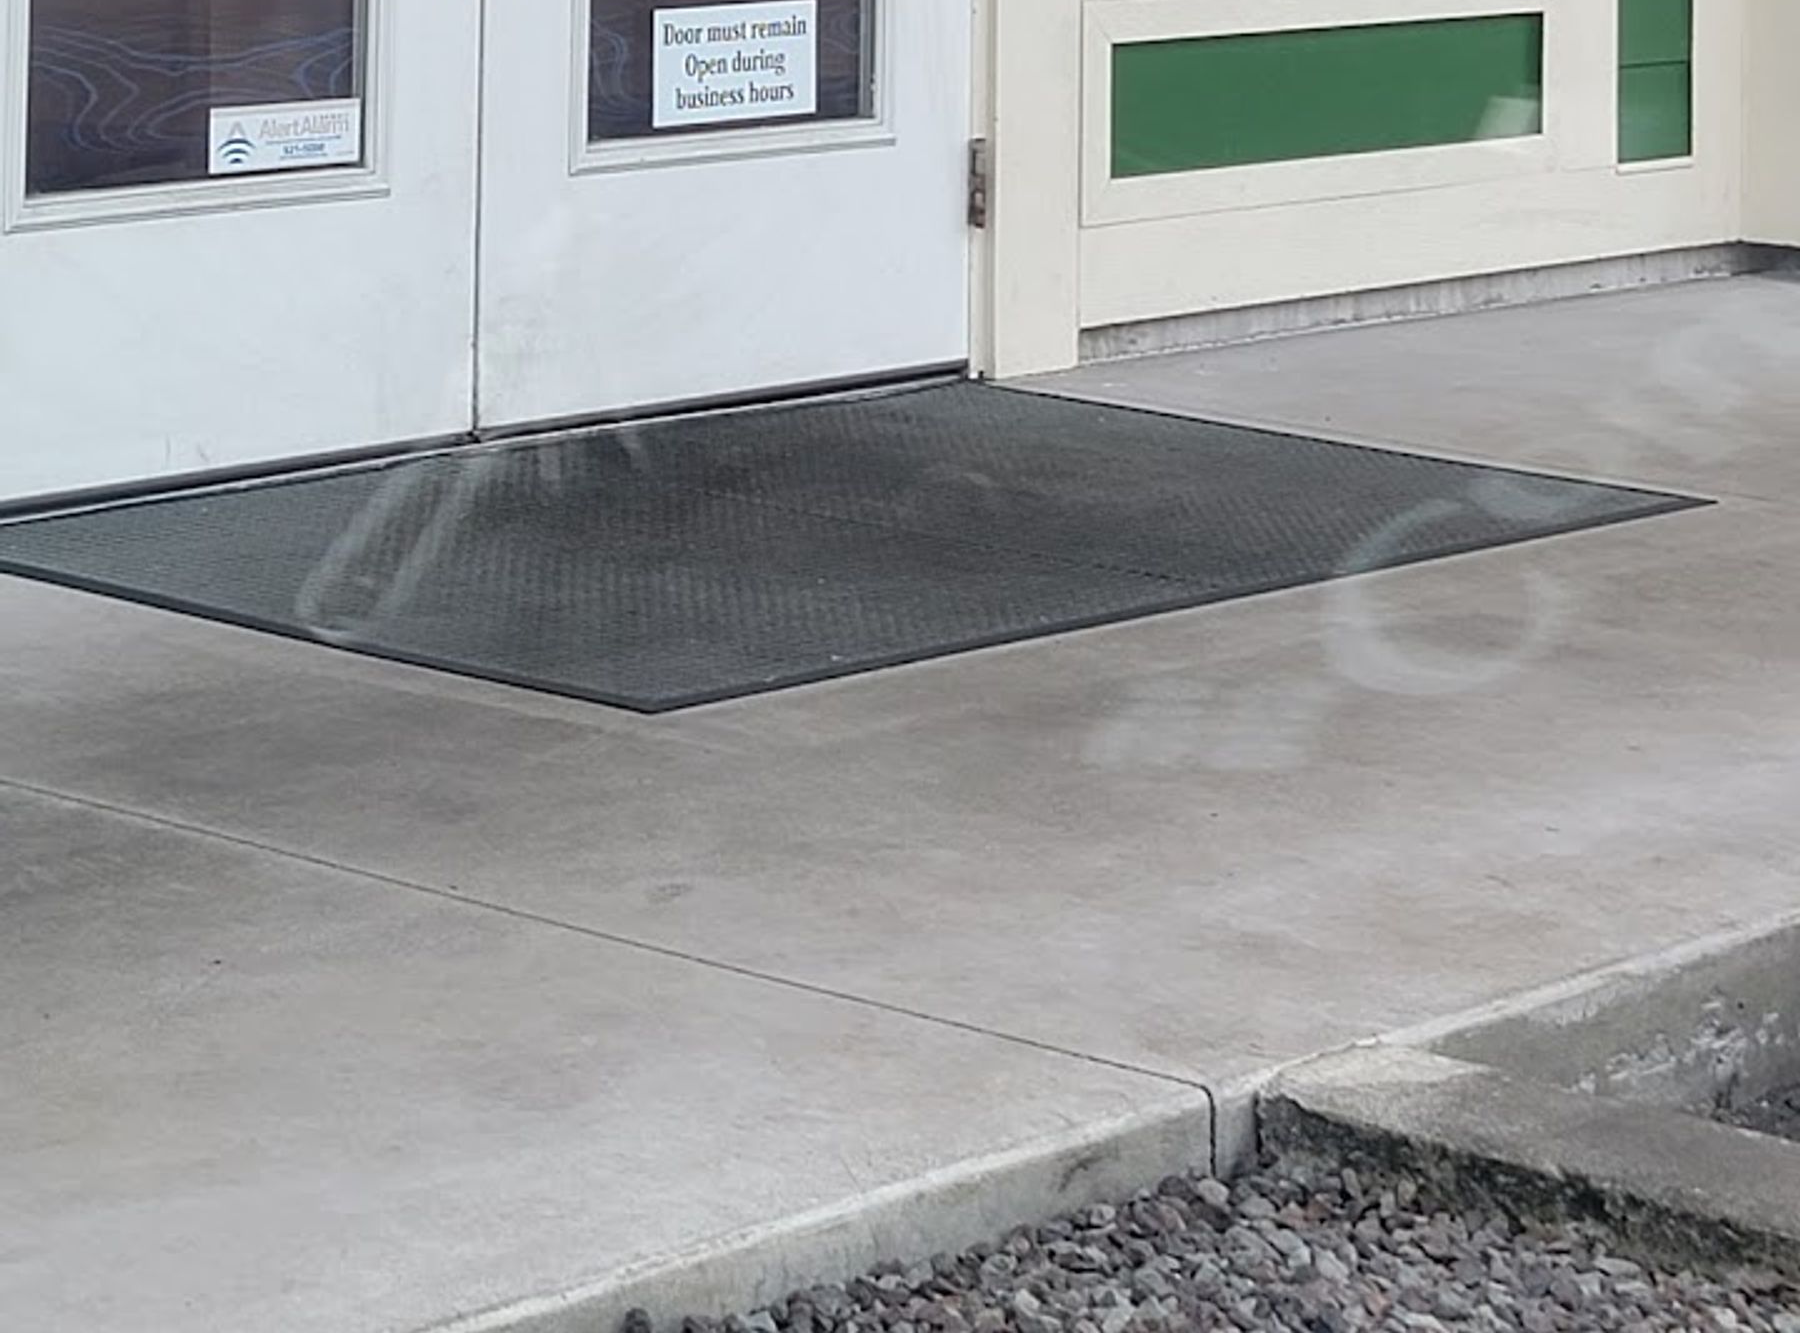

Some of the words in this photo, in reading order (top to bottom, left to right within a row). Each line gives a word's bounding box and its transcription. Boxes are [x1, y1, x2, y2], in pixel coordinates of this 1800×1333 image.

[663, 23, 703, 46] Door
[707, 21, 747, 43] must
[751, 15, 807, 39] remain
[685, 53, 728, 83] Open
[732, 48, 786, 76] during
[675, 85, 744, 110] business
[749, 81, 795, 104] hours
